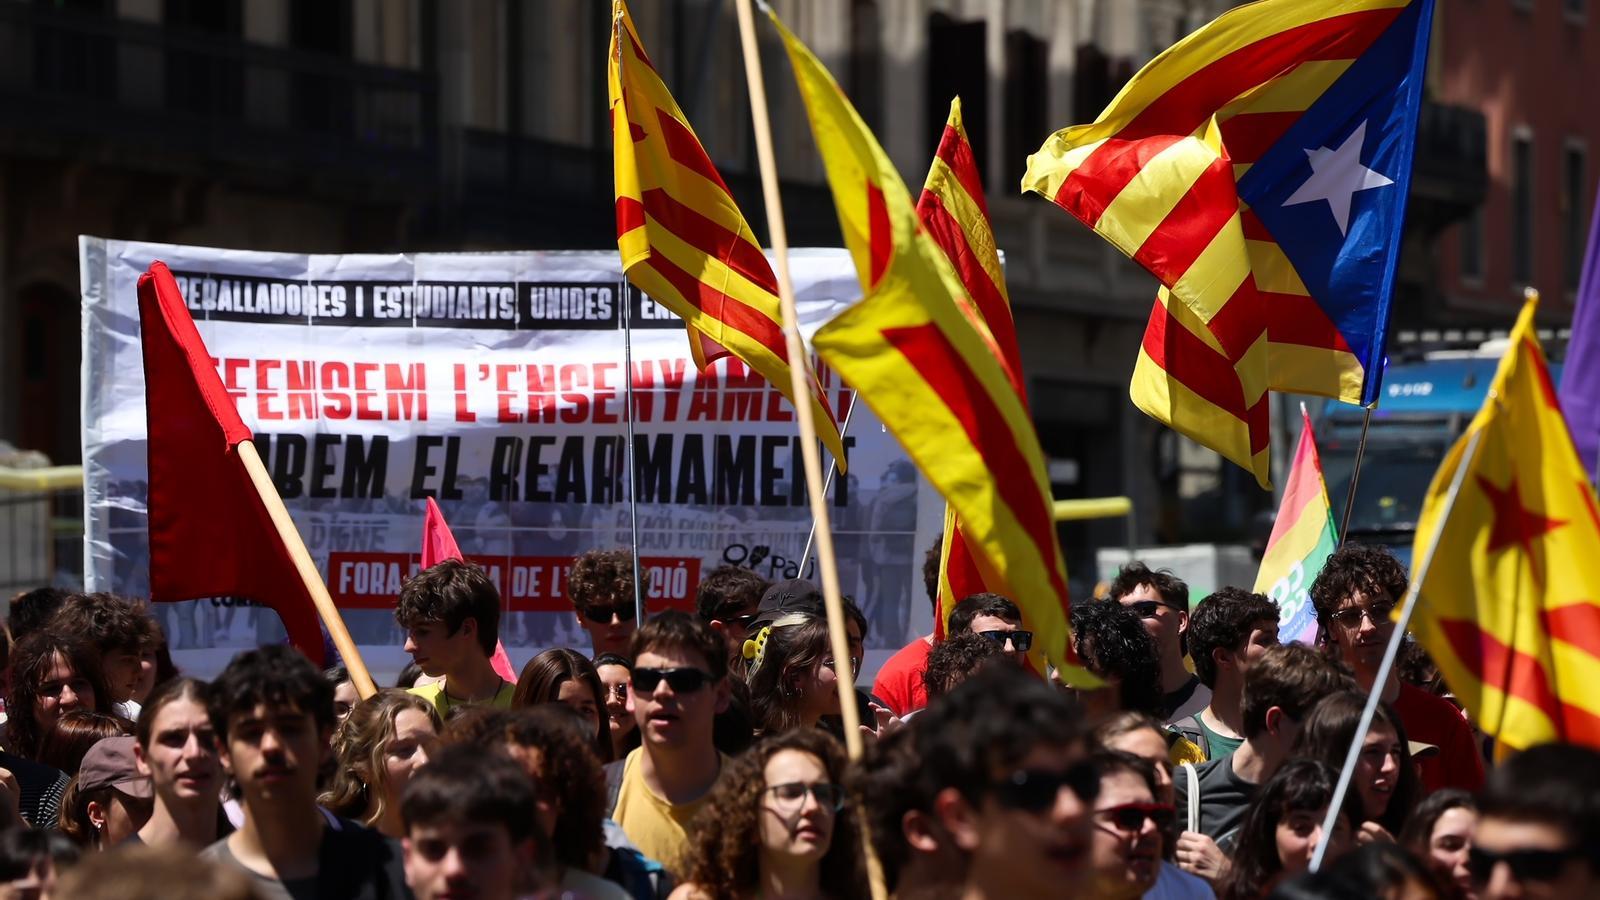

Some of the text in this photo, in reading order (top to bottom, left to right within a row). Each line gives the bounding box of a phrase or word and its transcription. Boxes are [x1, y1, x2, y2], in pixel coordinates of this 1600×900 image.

[355, 285, 364, 317] I
[373, 285, 521, 323] ESTUDIANTS,
[530, 286, 612, 320] UNIDES
[211, 357, 428, 421] FENSEM
[410, 435, 464, 500] EL
[339, 561, 401, 595] FORA
[512, 565, 541, 598] DE
